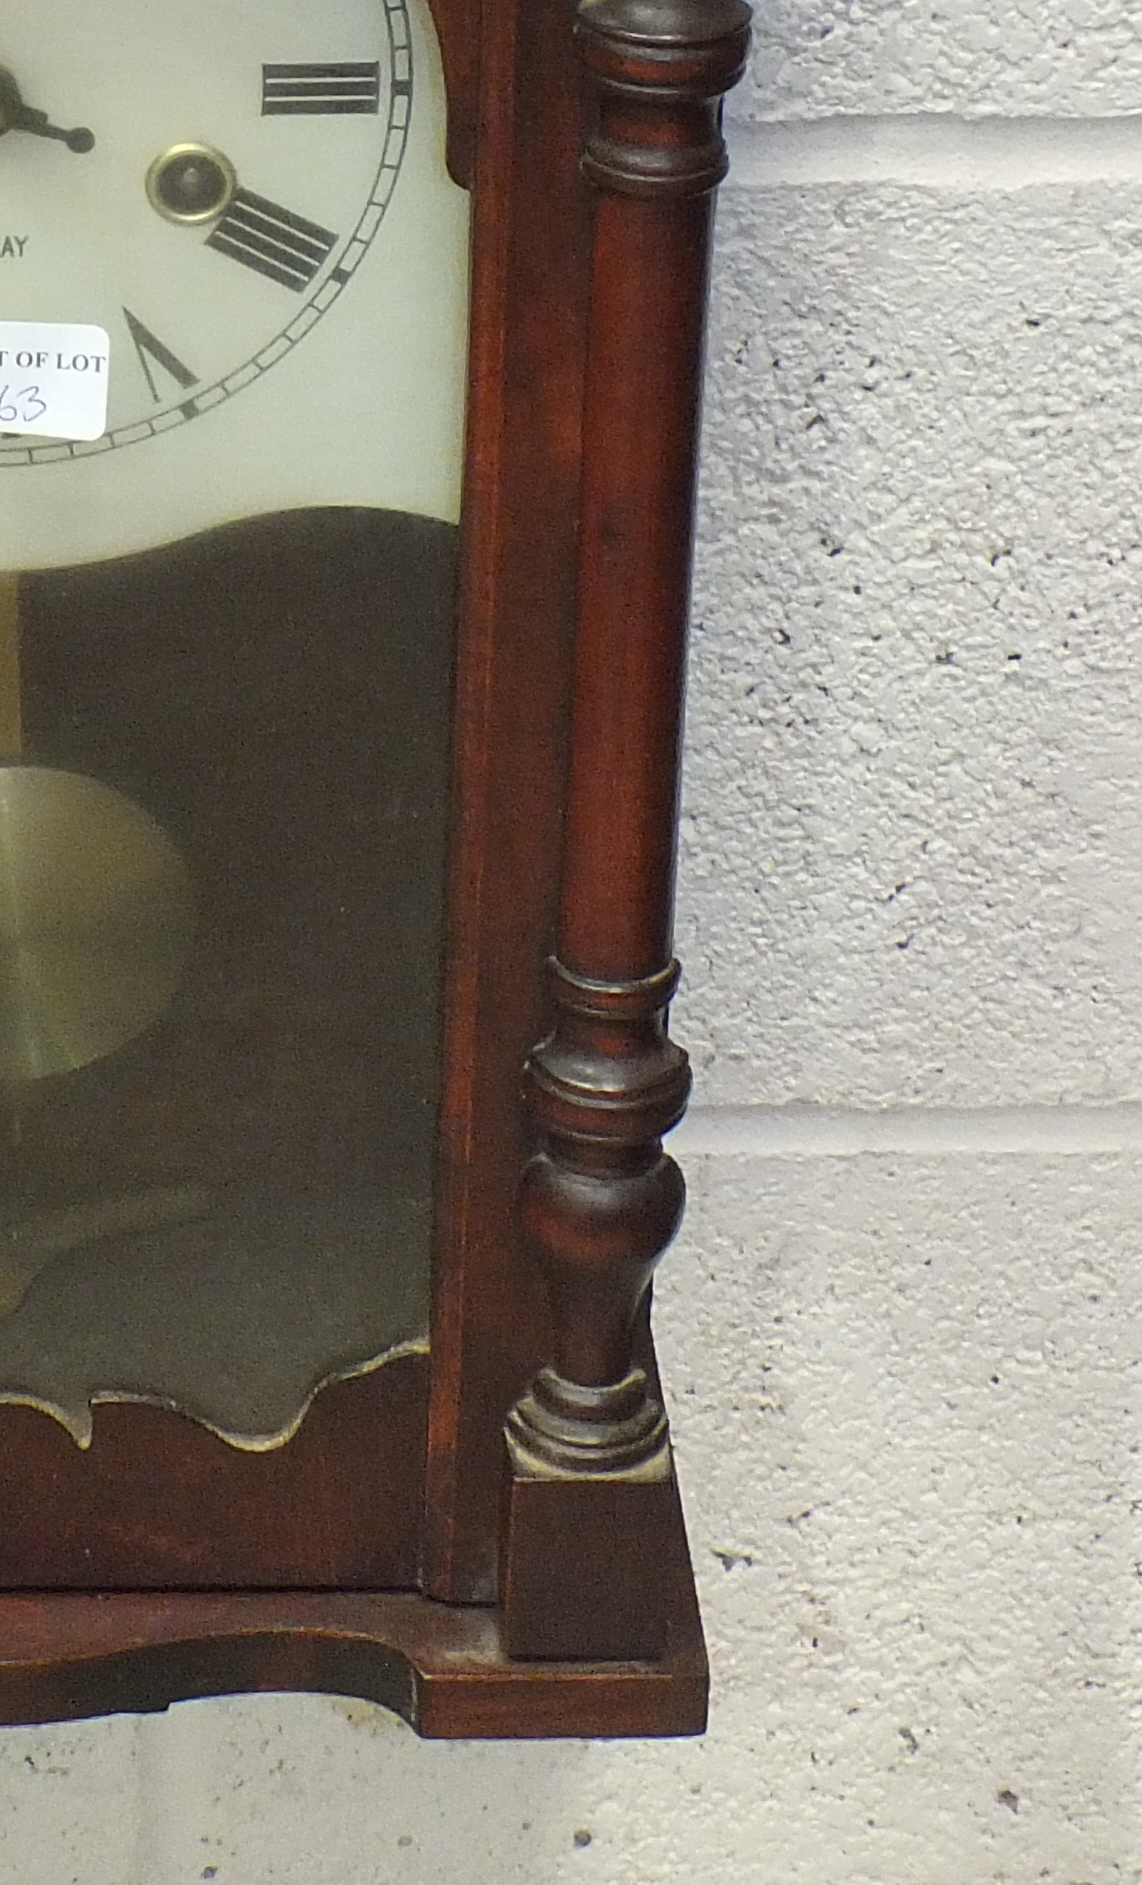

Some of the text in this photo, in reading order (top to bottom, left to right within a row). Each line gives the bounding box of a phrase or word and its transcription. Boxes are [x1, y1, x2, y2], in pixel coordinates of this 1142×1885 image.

[261, 61, 379, 116] III
[204, 186, 339, 293] IIII
[15, 350, 49, 368] OF
[56, 352, 107, 373] LOT
[122, 305, 200, 403] V
